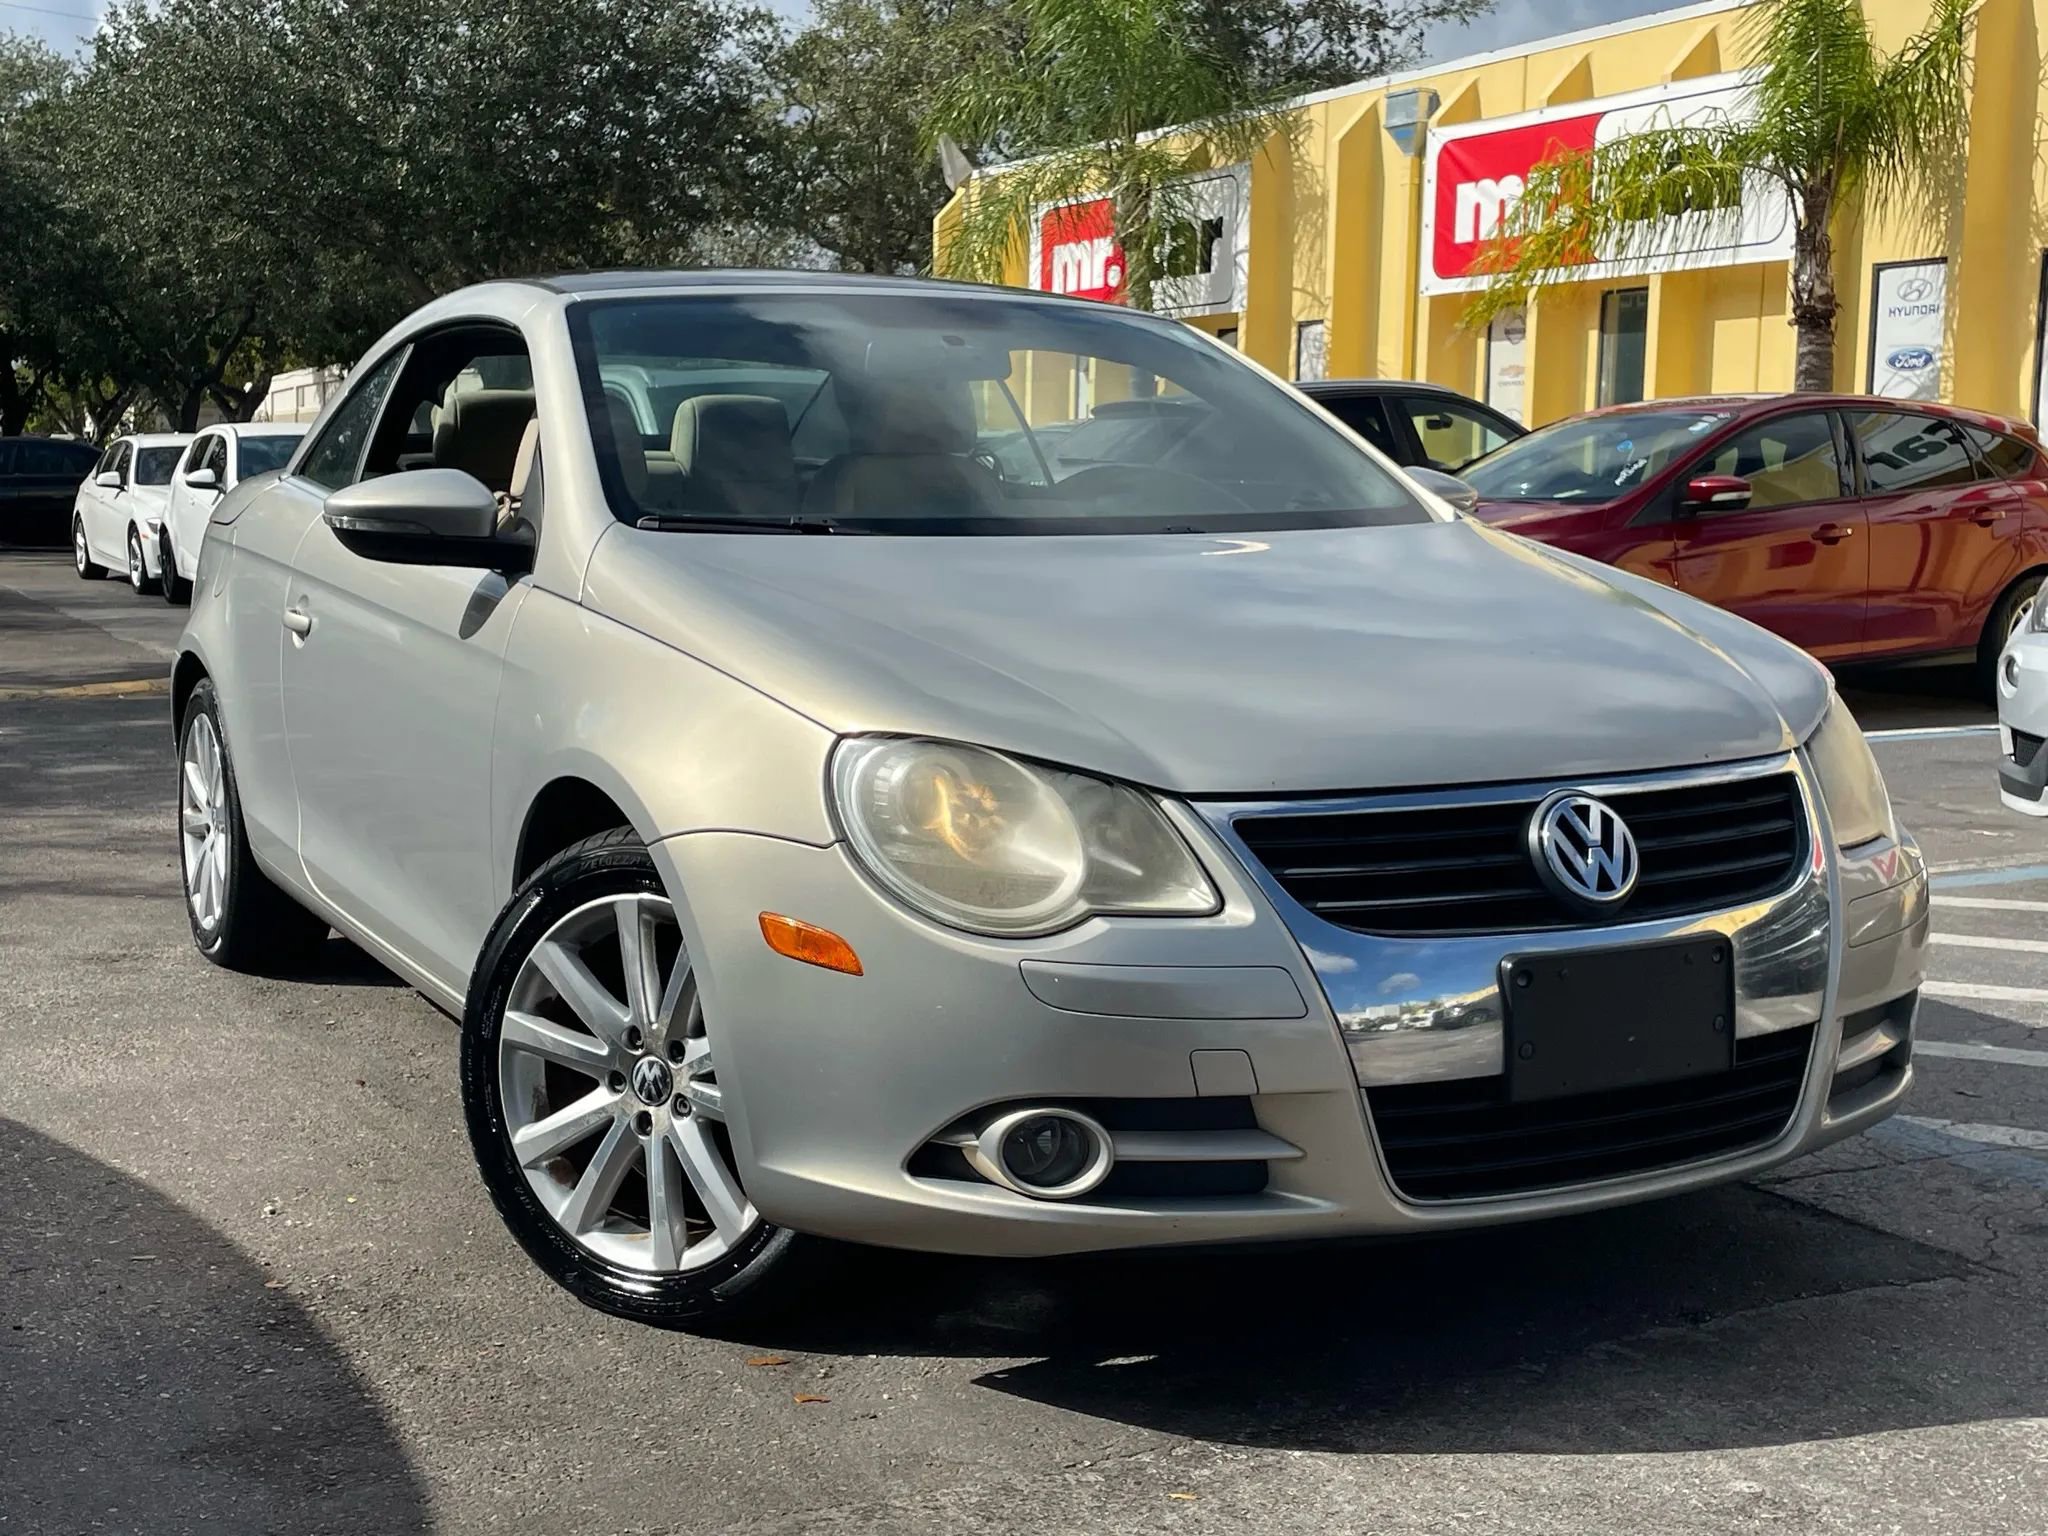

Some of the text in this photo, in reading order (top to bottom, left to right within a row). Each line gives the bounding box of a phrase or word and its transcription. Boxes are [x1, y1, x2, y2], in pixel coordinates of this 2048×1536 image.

[1052, 236, 1123, 293] mr.
[1888, 304, 1940, 318] HYUNDAI
[1893, 351, 1928, 368] Ford
